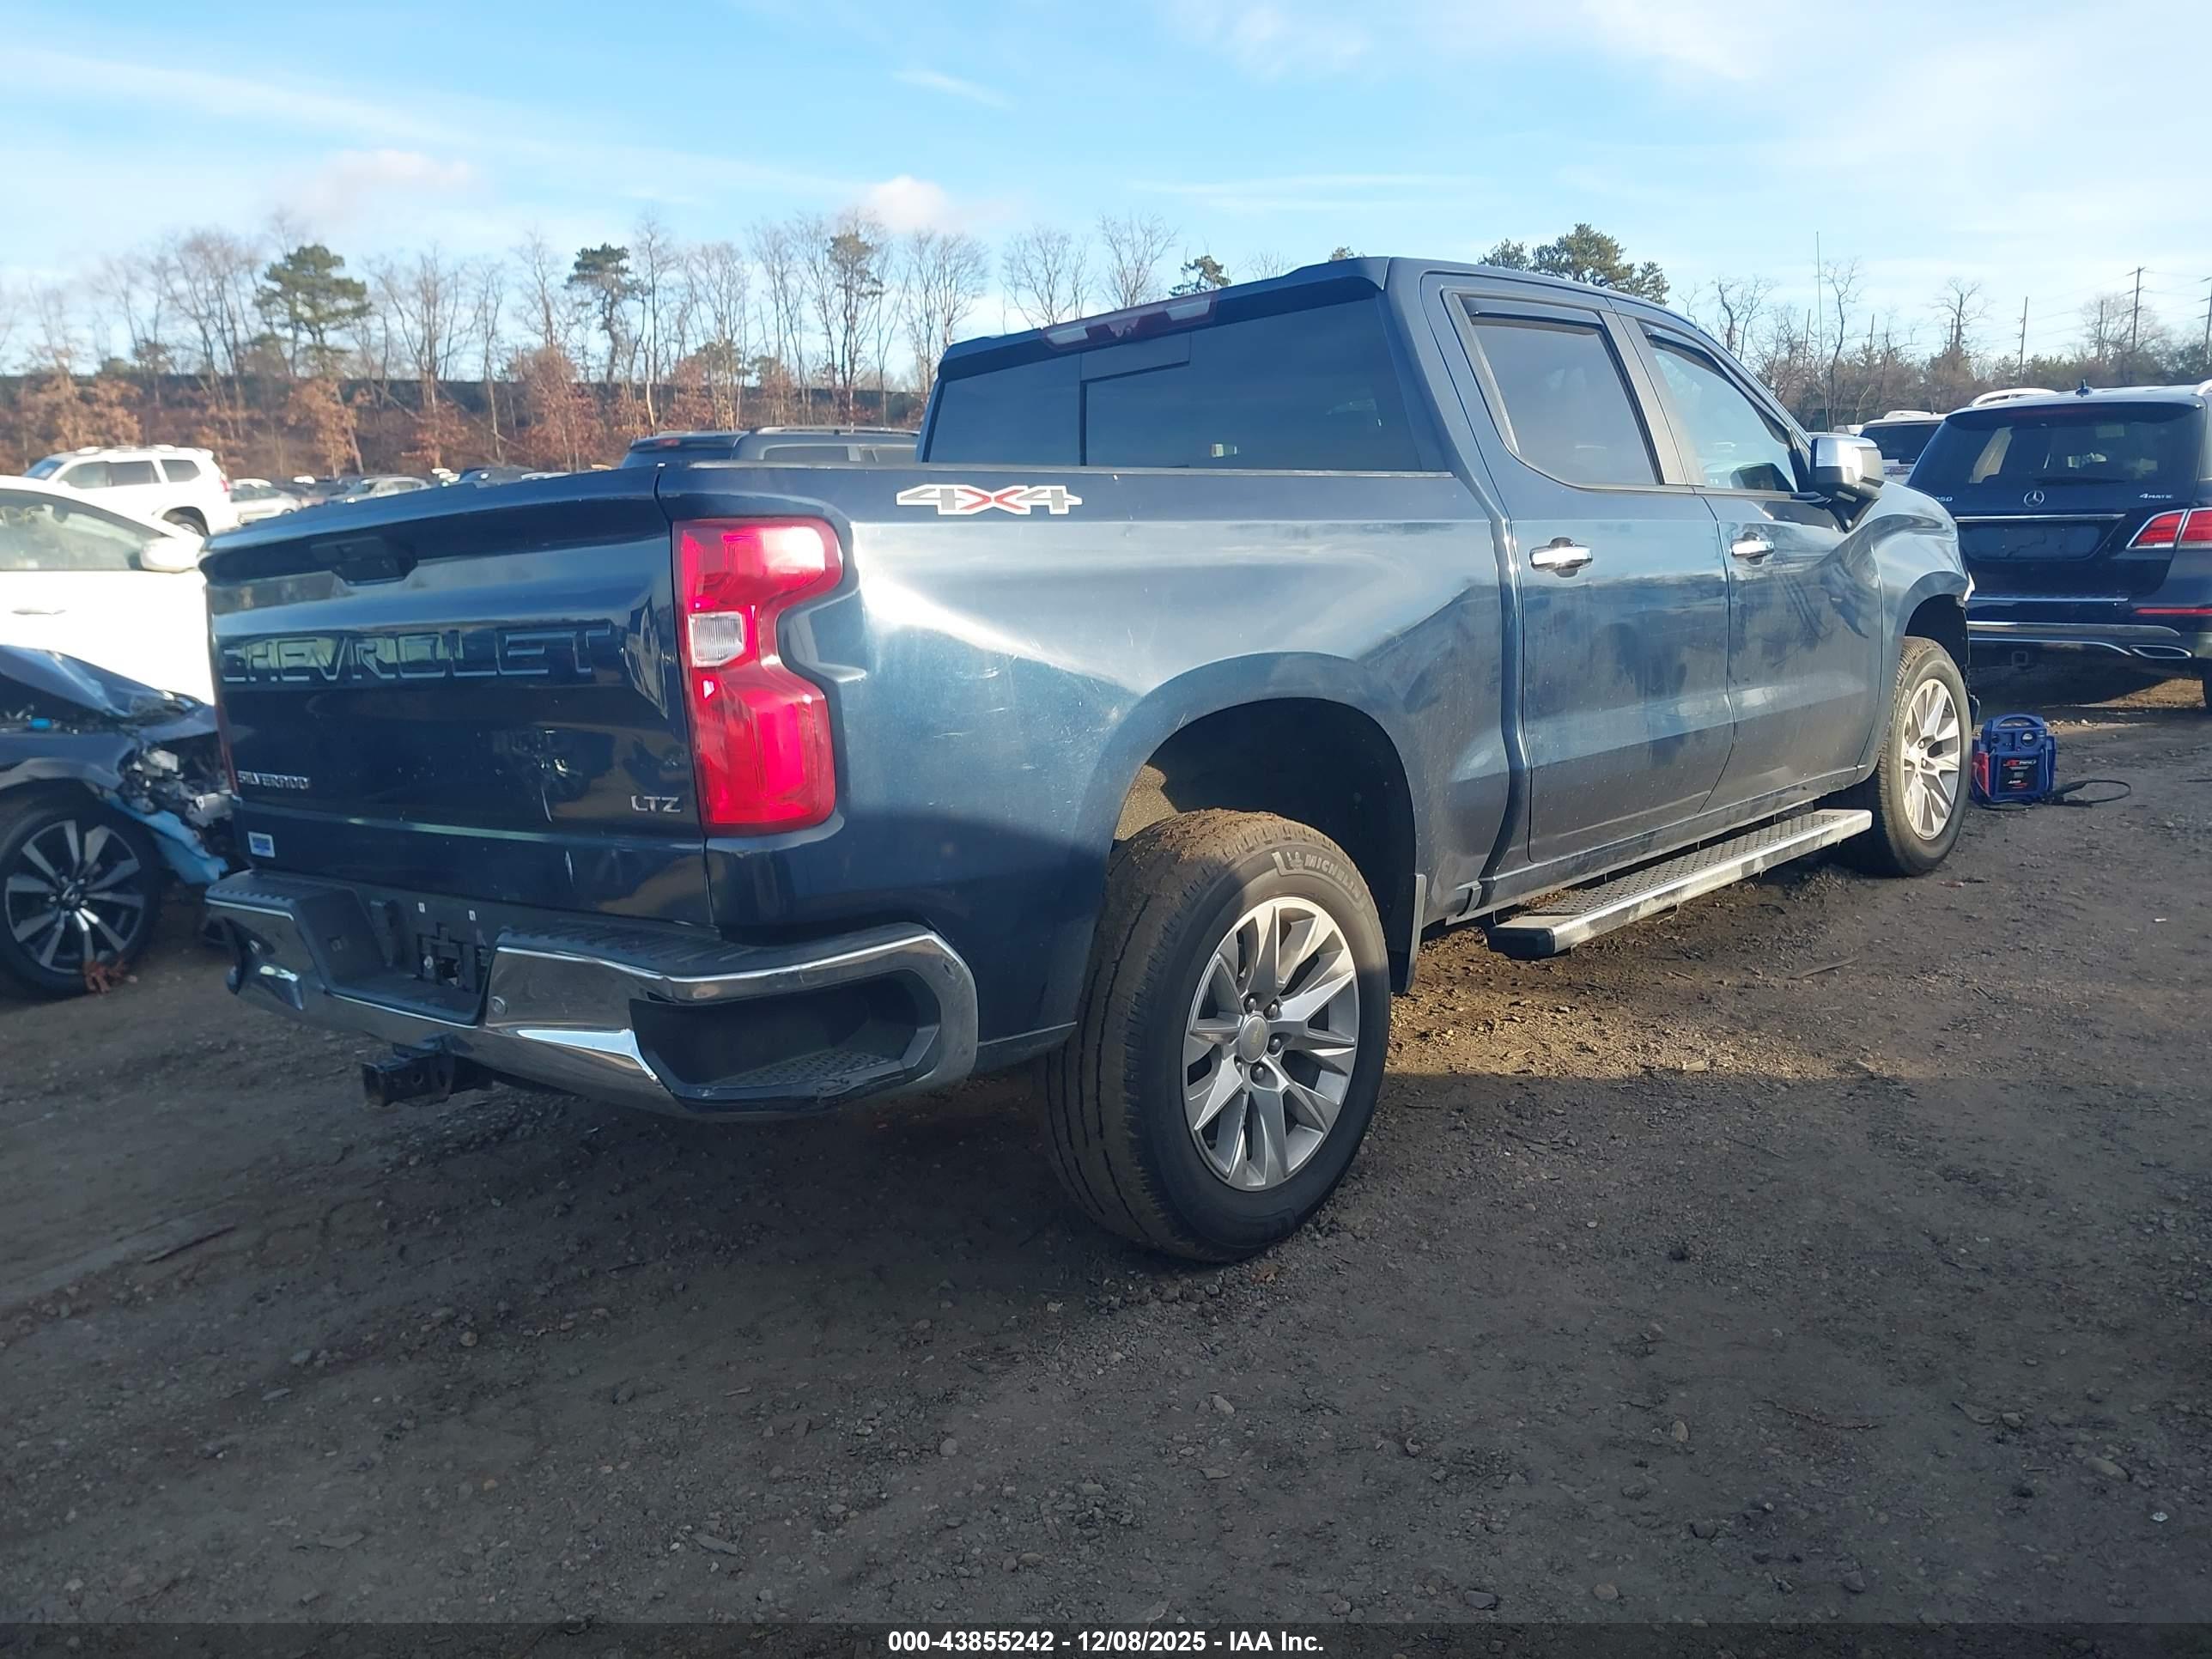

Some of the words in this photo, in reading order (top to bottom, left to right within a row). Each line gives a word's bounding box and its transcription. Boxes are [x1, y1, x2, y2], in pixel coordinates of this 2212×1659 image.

[222, 623, 611, 683] CHEVROLET
[237, 770, 311, 790] SILVERADO
[630, 795, 681, 813] LTZ
[1304, 854, 1362, 899] MICHELIN
